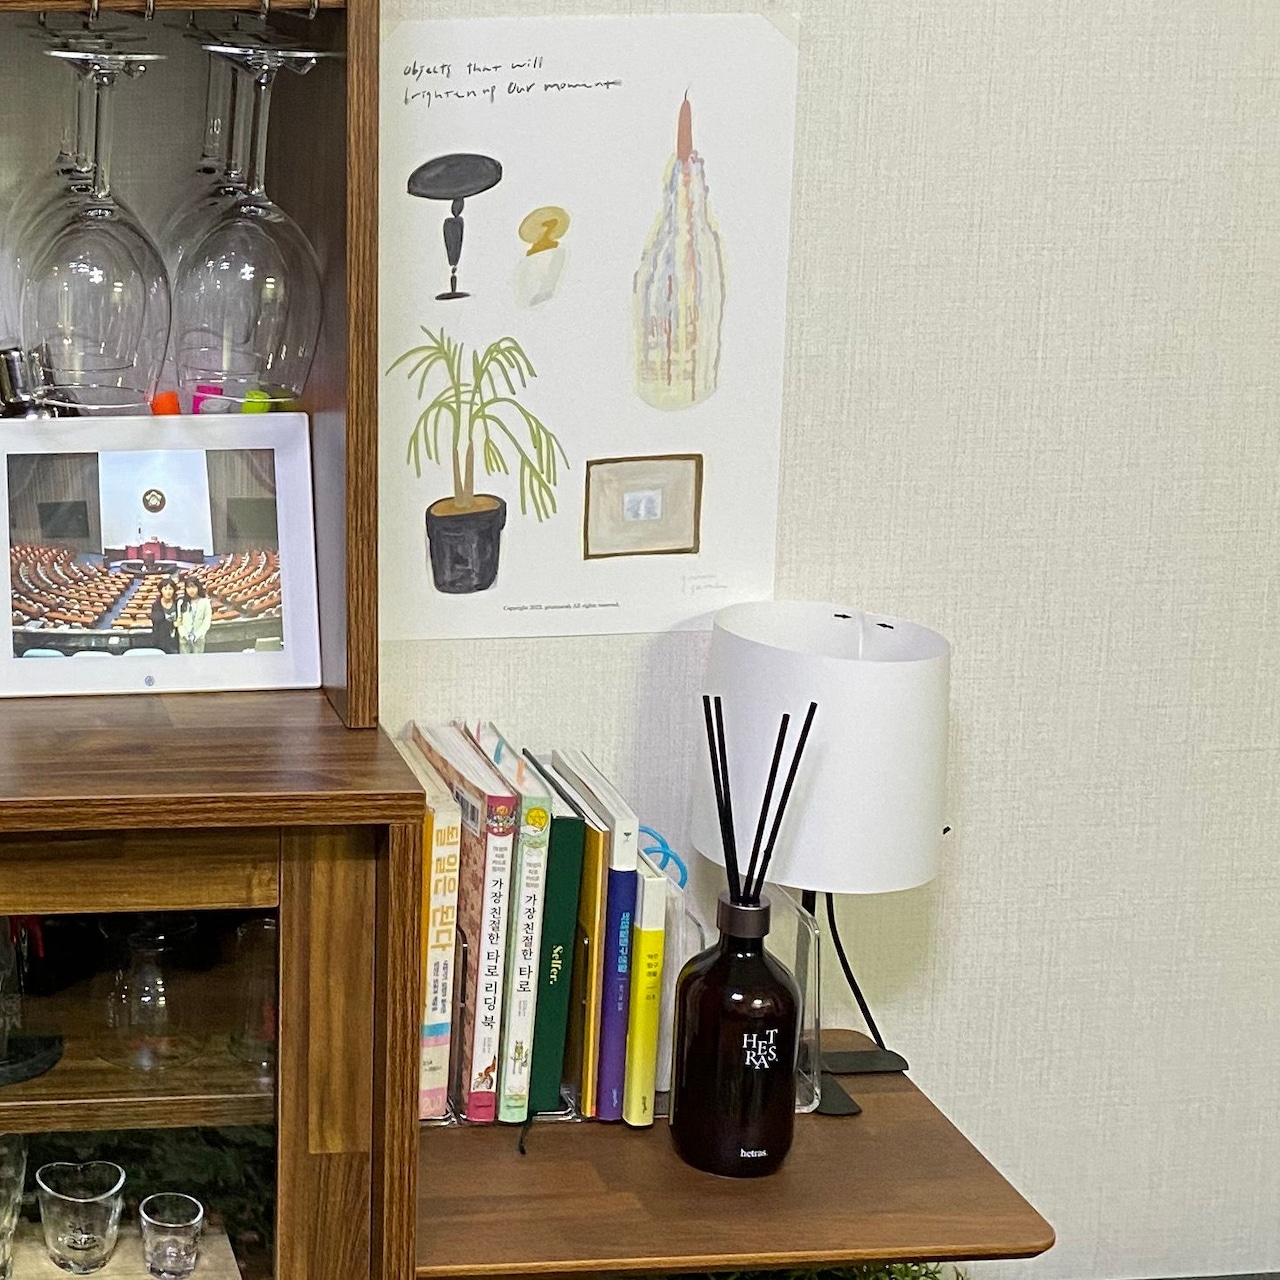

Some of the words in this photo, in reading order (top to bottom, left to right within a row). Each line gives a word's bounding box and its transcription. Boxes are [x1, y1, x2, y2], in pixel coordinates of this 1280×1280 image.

[467, 62, 502, 76] that
[511, 56, 543, 70] will
[435, 825, 459, 847] 될
[433, 854, 458, 897] 일은
[489, 878, 504, 904] 가장
[524, 893, 538, 920] 가장
[431, 904, 455, 952] 된다
[487, 906, 502, 946] 친절한
[521, 922, 535, 961] 친절한
[485, 950, 501, 978] 타로
[516, 966, 533, 993] 타로
[484, 981, 498, 1012] 리딩
[481, 1015, 496, 1030] 북
